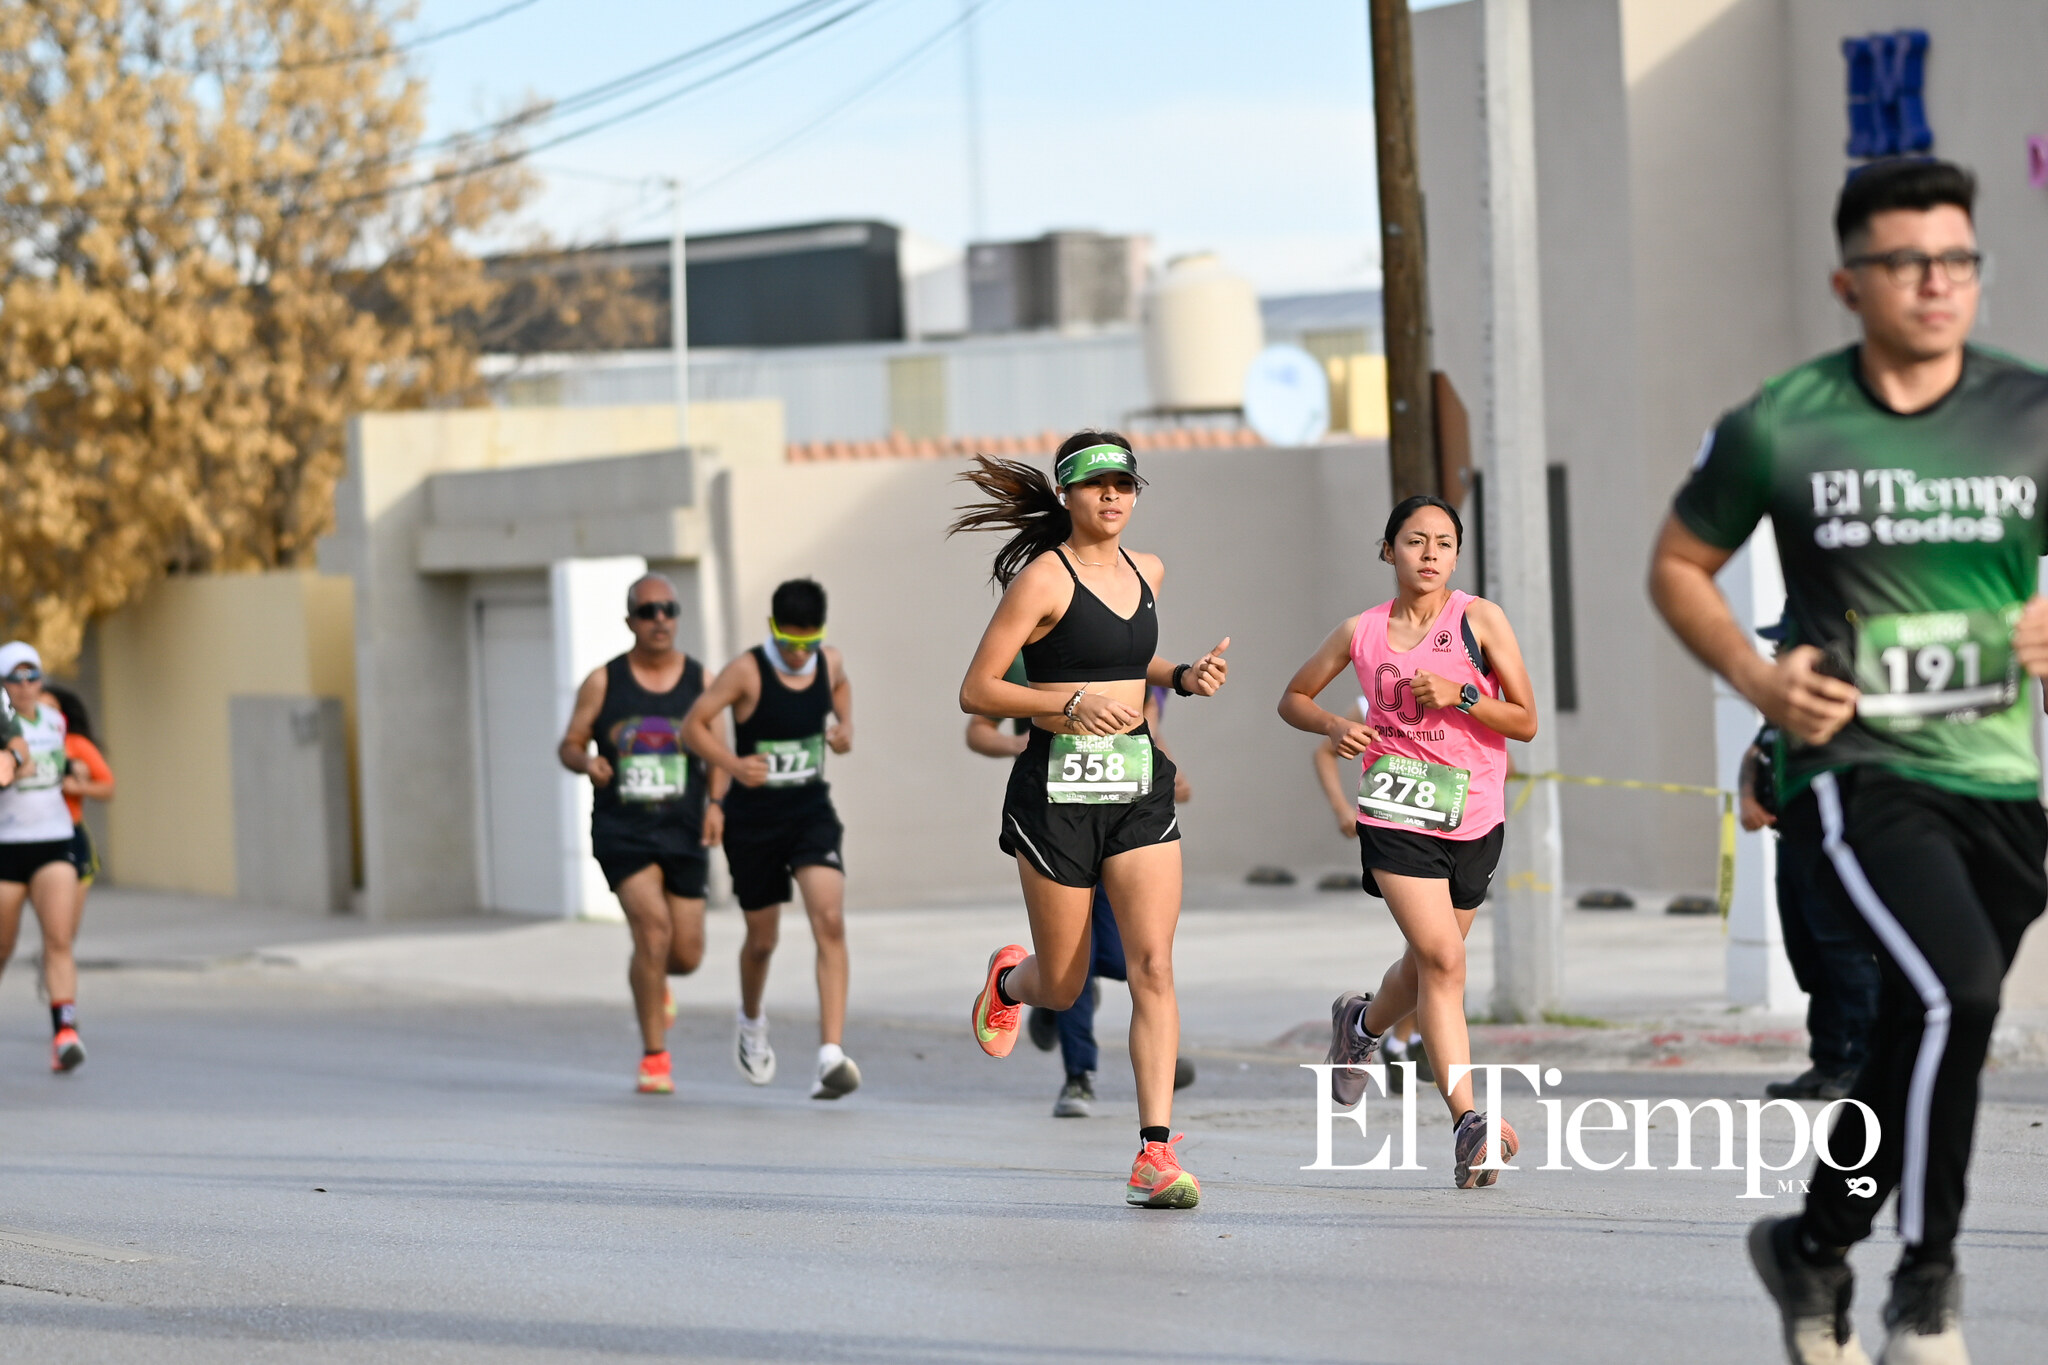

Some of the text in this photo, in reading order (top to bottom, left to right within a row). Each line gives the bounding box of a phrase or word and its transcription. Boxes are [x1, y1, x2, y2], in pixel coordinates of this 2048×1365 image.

[1811, 468, 2037, 518] El Tiempo
[1814, 512, 2005, 549] de todos
[1882, 641, 1981, 694] 191
[1407, 729, 1445, 742] CASTILLO
[1062, 753, 1125, 782] 558
[1141, 748, 1149, 795] MEDALLA
[1370, 772, 1436, 808] 278
[1449, 784, 1465, 827] MEDALLA
